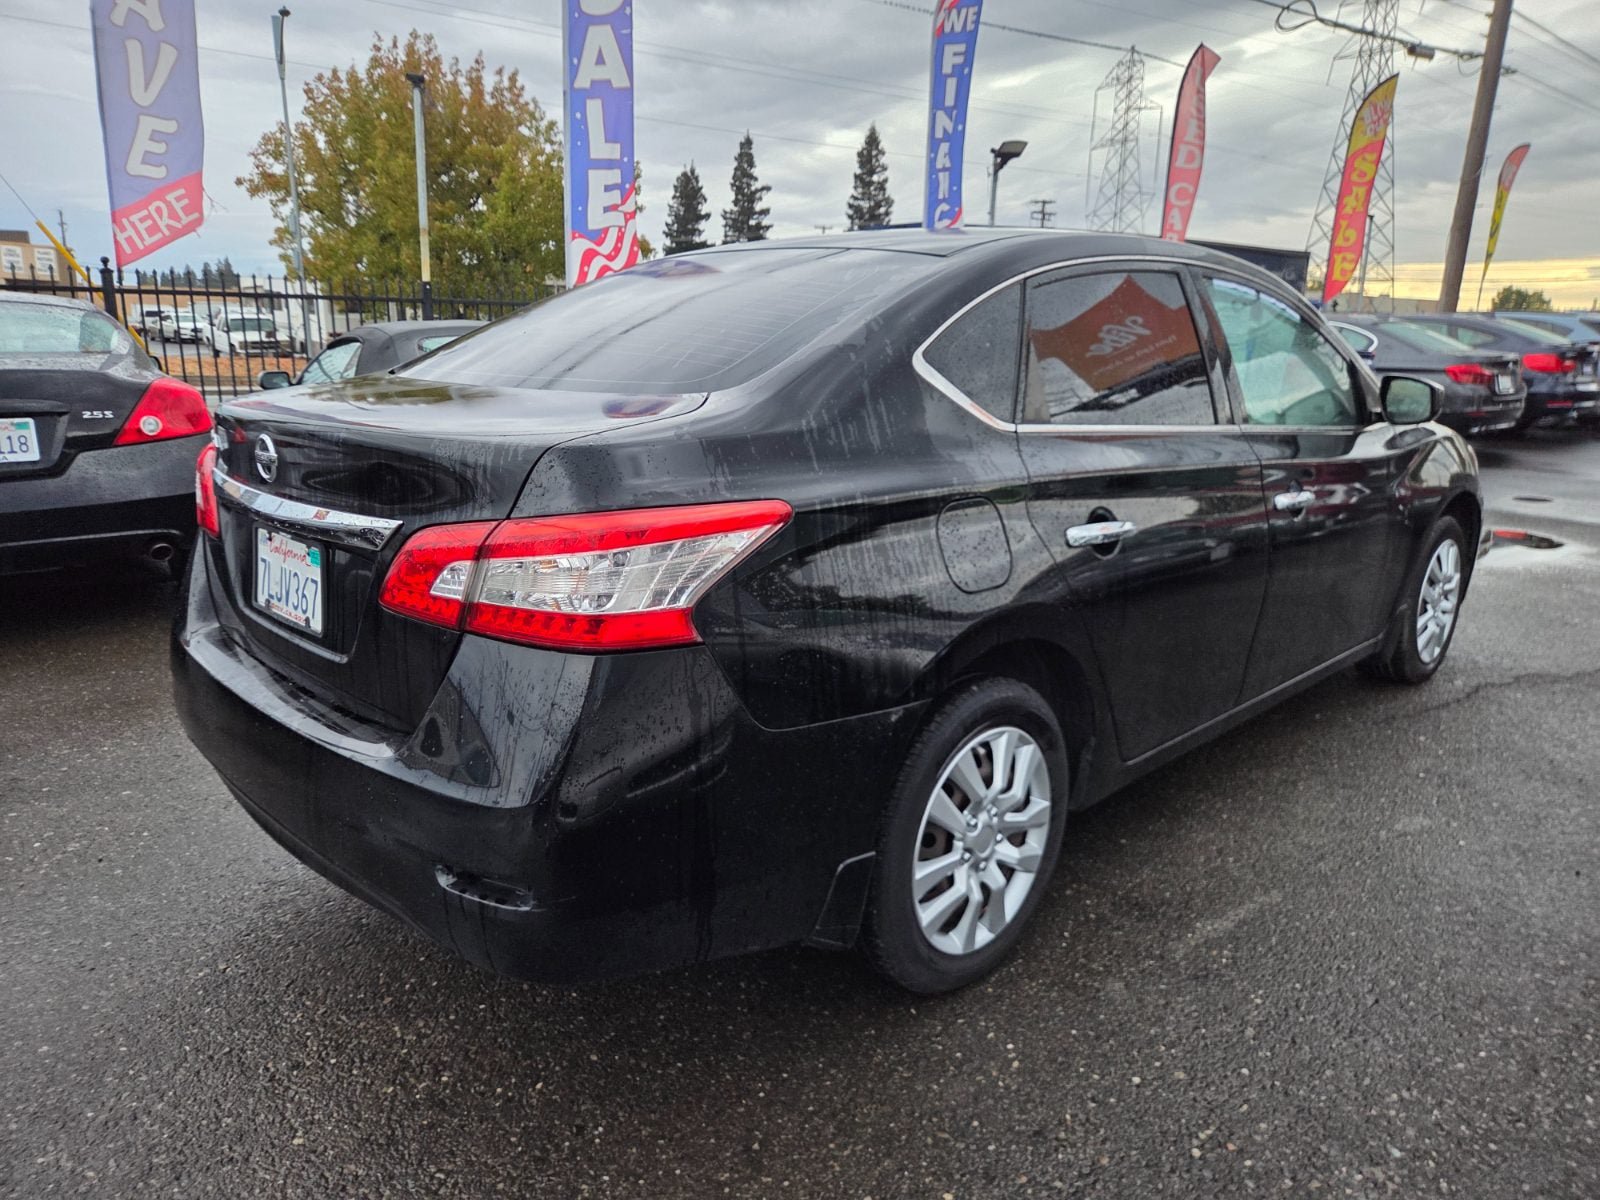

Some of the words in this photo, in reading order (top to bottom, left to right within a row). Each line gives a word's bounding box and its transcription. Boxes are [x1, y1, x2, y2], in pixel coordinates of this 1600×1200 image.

[943, 6, 978, 33] WE
[573, 0, 632, 230] ALE
[112, 188, 200, 254] HERE
[1332, 152, 1377, 282] SALE
[260, 557, 319, 620] 7LJV367
